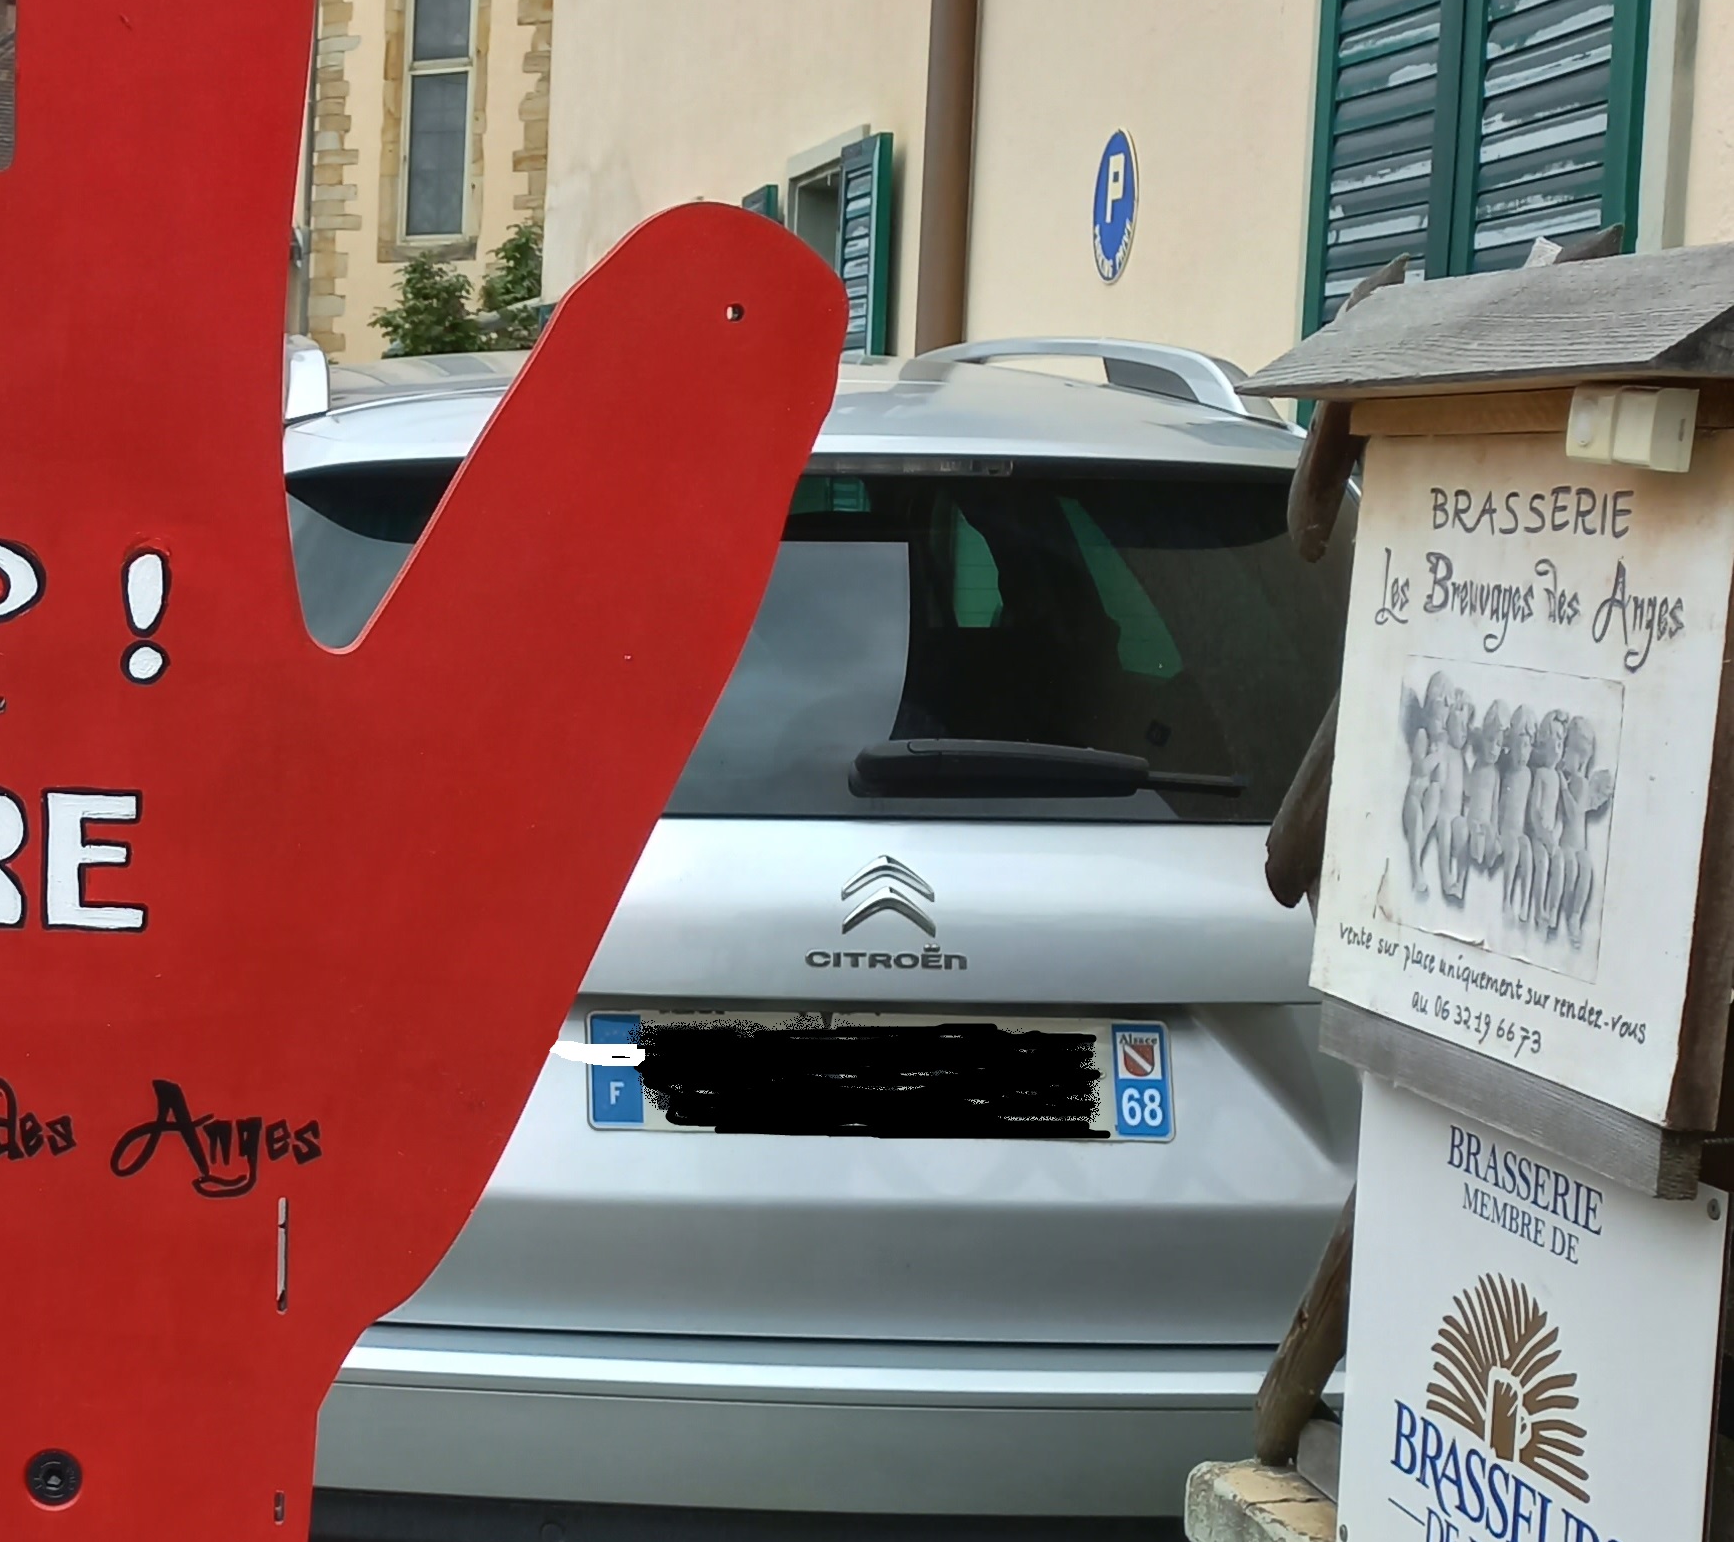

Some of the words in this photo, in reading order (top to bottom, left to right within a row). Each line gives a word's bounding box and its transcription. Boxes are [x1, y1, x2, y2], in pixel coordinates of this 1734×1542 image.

[1105, 152, 1125, 223] P
[1430, 485, 1634, 539] BRASSERIE
[120, 544, 170, 684] !
[1374, 547, 1409, 625] Les
[1423, 551, 1535, 653] Breuvages
[1534, 558, 1581, 625] des
[1592, 555, 1684, 673] Anges
[1339, 922, 1373, 950] vente
[1377, 938, 1400, 957] sur
[1403, 942, 1436, 973] place
[1438, 954, 1523, 1001] uniquement
[1524, 987, 1551, 1009] sur
[1553, 998, 1647, 1045] rendez-vous
[1411, 991, 1429, 1016] au
[1434, 995, 1451, 1021] 06
[1118, 1033, 1158, 1046] Alsace
[609, 1081, 625, 1105] F
[1121, 1087, 1163, 1127] 68
[110, 1079, 322, 1198] Anges
[1446, 1124, 1604, 1236] BRASSERIE
[1462, 1181, 1546, 1248] MEMBRE
[1550, 1225, 1580, 1265] DE
